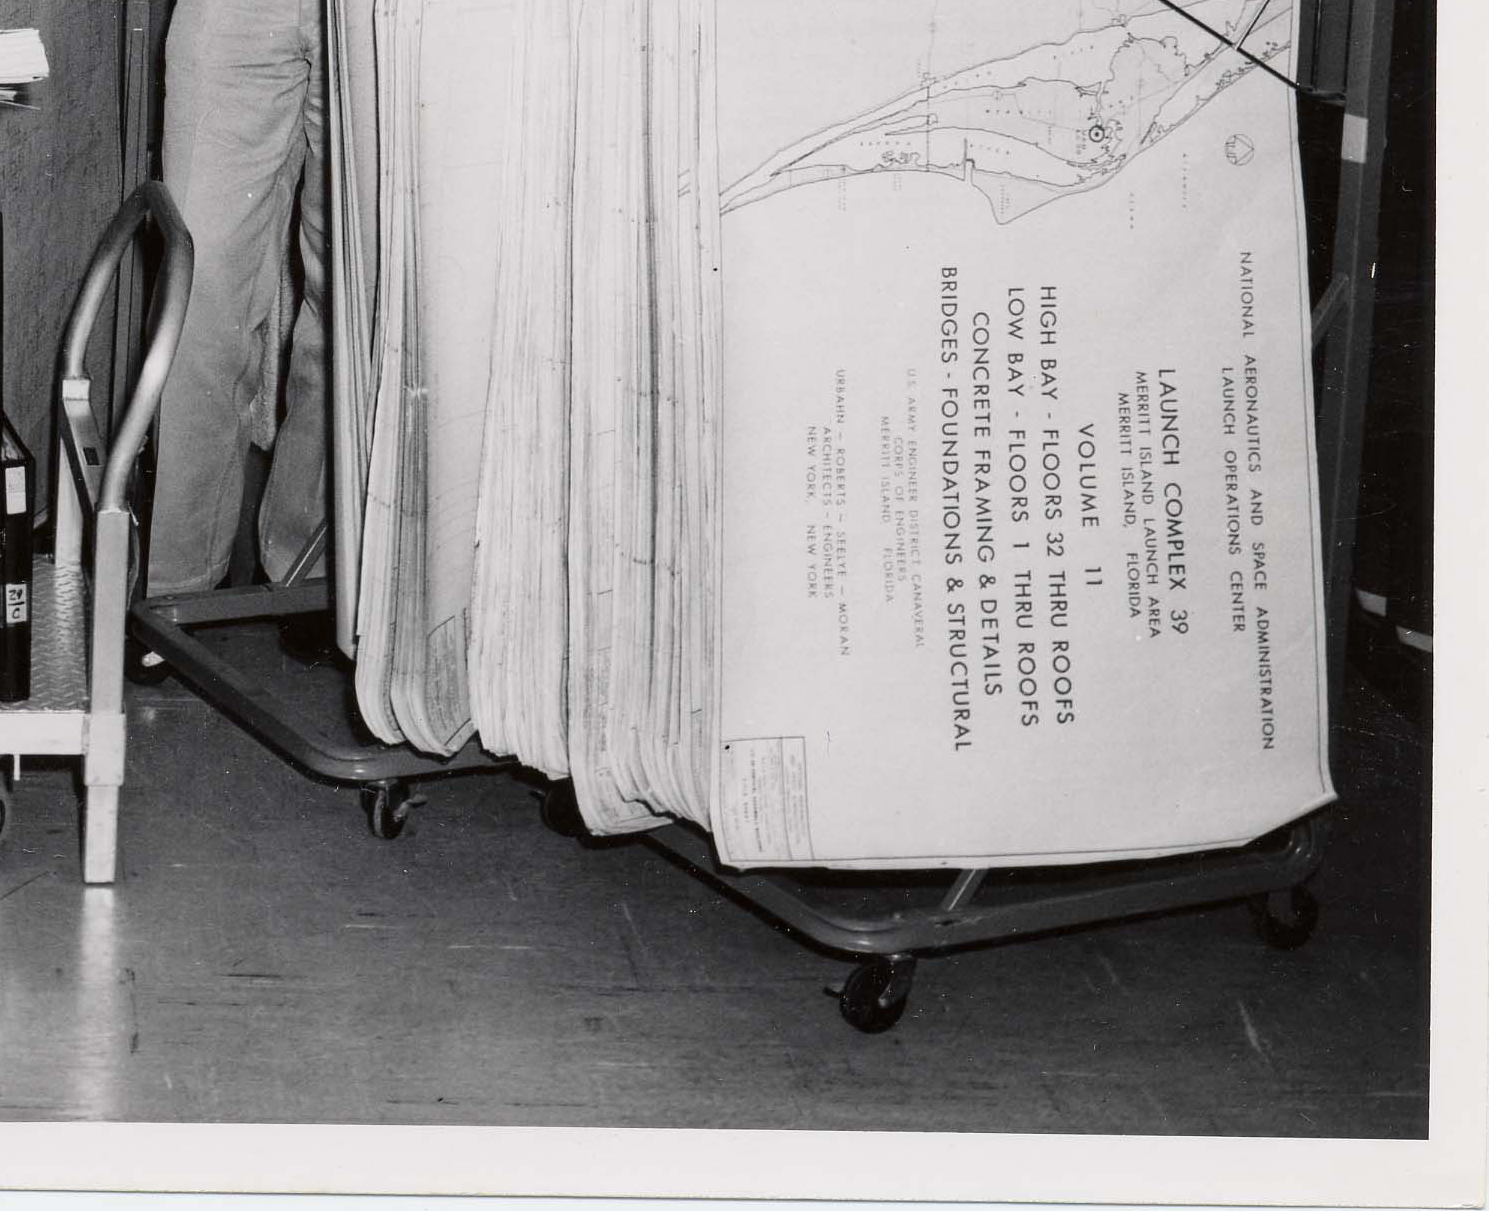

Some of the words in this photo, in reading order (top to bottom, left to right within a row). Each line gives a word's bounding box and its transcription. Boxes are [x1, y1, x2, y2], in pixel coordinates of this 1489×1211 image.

[941, 268, 958, 363] BRIDGES
[1008, 288, 1025, 339] LOW
[1040, 287, 1056, 344] HIGH
[1241, 252, 1254, 337] NATIONAL
[836, 370, 845, 423] URBAHN
[973, 312, 990, 436] CONCRETE
[1008, 353, 1024, 396] BAY
[1041, 359, 1057, 399] BAY
[1136, 372, 1150, 433] MERRITT
[1222, 368, 1235, 434] LAUNCH
[807, 427, 816, 456] NEW
[881, 417, 890, 467] MERRITT
[908, 398, 916, 431] ARMY
[1118, 393, 1132, 454] MERRITT
[1159, 370, 1180, 465] LAUNCH
[1245, 355, 1261, 472] AERONAUTICS
[822, 427, 832, 505] ARCHITECTS
[836, 449, 846, 505] ROBERTS
[894, 438, 904, 476] CORPS
[908, 441, 918, 501] ENGINEER
[942, 389, 962, 564] FOUNDATIONS
[1009, 430, 1029, 522] FLOORS
[1043, 430, 1062, 519] FLOORS
[1078, 424, 1099, 526] VOLUME
[1140, 447, 1154, 504] ISLAND
[895, 486, 904, 501] OF
[974, 450, 994, 562] FRAMING
[1121, 468, 1136, 527] ISLAND,
[1224, 451, 1241, 555] OPERATIONS
[1251, 490, 1263, 525] AND
[807, 525, 816, 555] NEW
[823, 525, 834, 598] ENGINEERS
[836, 532, 846, 576] SEELYE
[895, 511, 906, 581] ENGINEERS
[909, 510, 921, 564] DISTRICT
[1047, 533, 1064, 556] 32
[1144, 519, 1158, 584] LAUNCH
[1164, 483, 1186, 590] COMPLEX
[1252, 542, 1267, 589] SPACE
[807, 564, 817, 597] YORK
[884, 548, 894, 602] FLORIDA
[947, 578, 963, 592] &
[979, 574, 996, 589] &
[1014, 570, 1033, 628] THRU
[1049, 571, 1067, 627] THRU
[1085, 567, 1102, 585] 11
[1126, 553, 1141, 618] FLORIDA
[1230, 571, 1245, 631] CENTER
[12, 608, 20, 619] C
[839, 603, 849, 655] MORAN
[911, 575, 924, 647] CANAVERAL
[1149, 597, 1161, 638] AREA
[1171, 610, 1188, 634] 39
[981, 600, 1002, 695] DETAILS
[947, 604, 971, 750] STRUCTURAL
[1018, 643, 1039, 726] ROOFS
[1052, 641, 1074, 724] ROOFS
[1257, 607, 1274, 749] ADMINISTRATION
